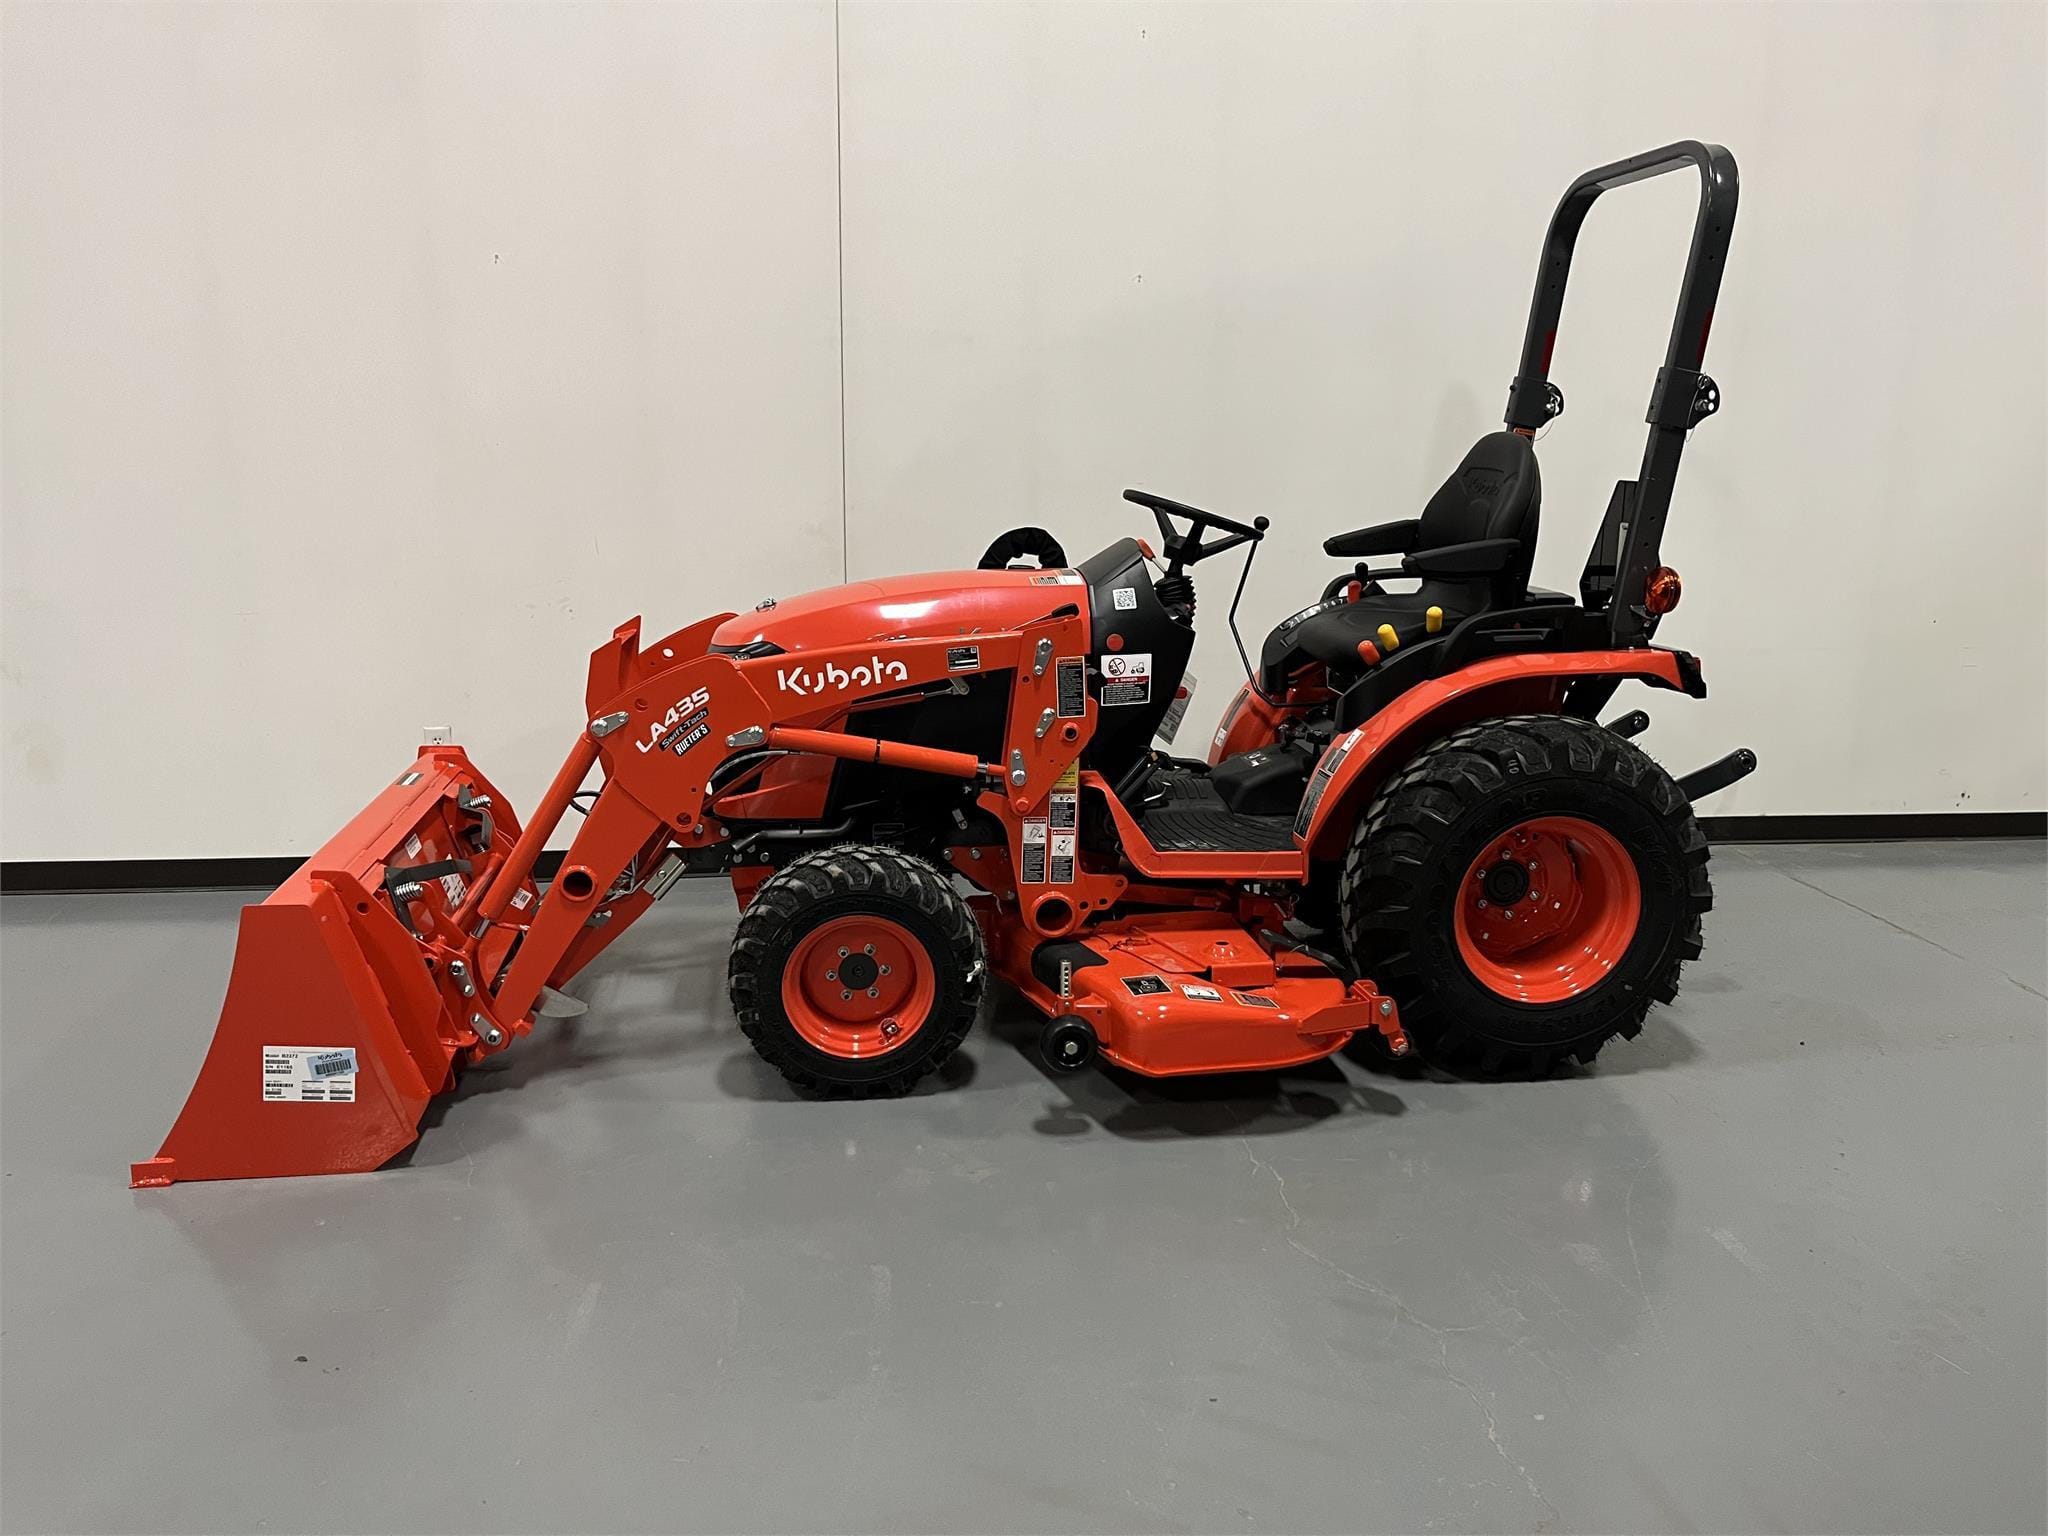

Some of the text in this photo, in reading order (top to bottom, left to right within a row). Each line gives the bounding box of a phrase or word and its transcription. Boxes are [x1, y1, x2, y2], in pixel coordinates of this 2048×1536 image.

[776, 656, 908, 696] Kubota
[635, 686, 710, 753] LA435
[661, 710, 707, 748] Swift-Tach
[674, 723, 708, 755] RUETER'S
